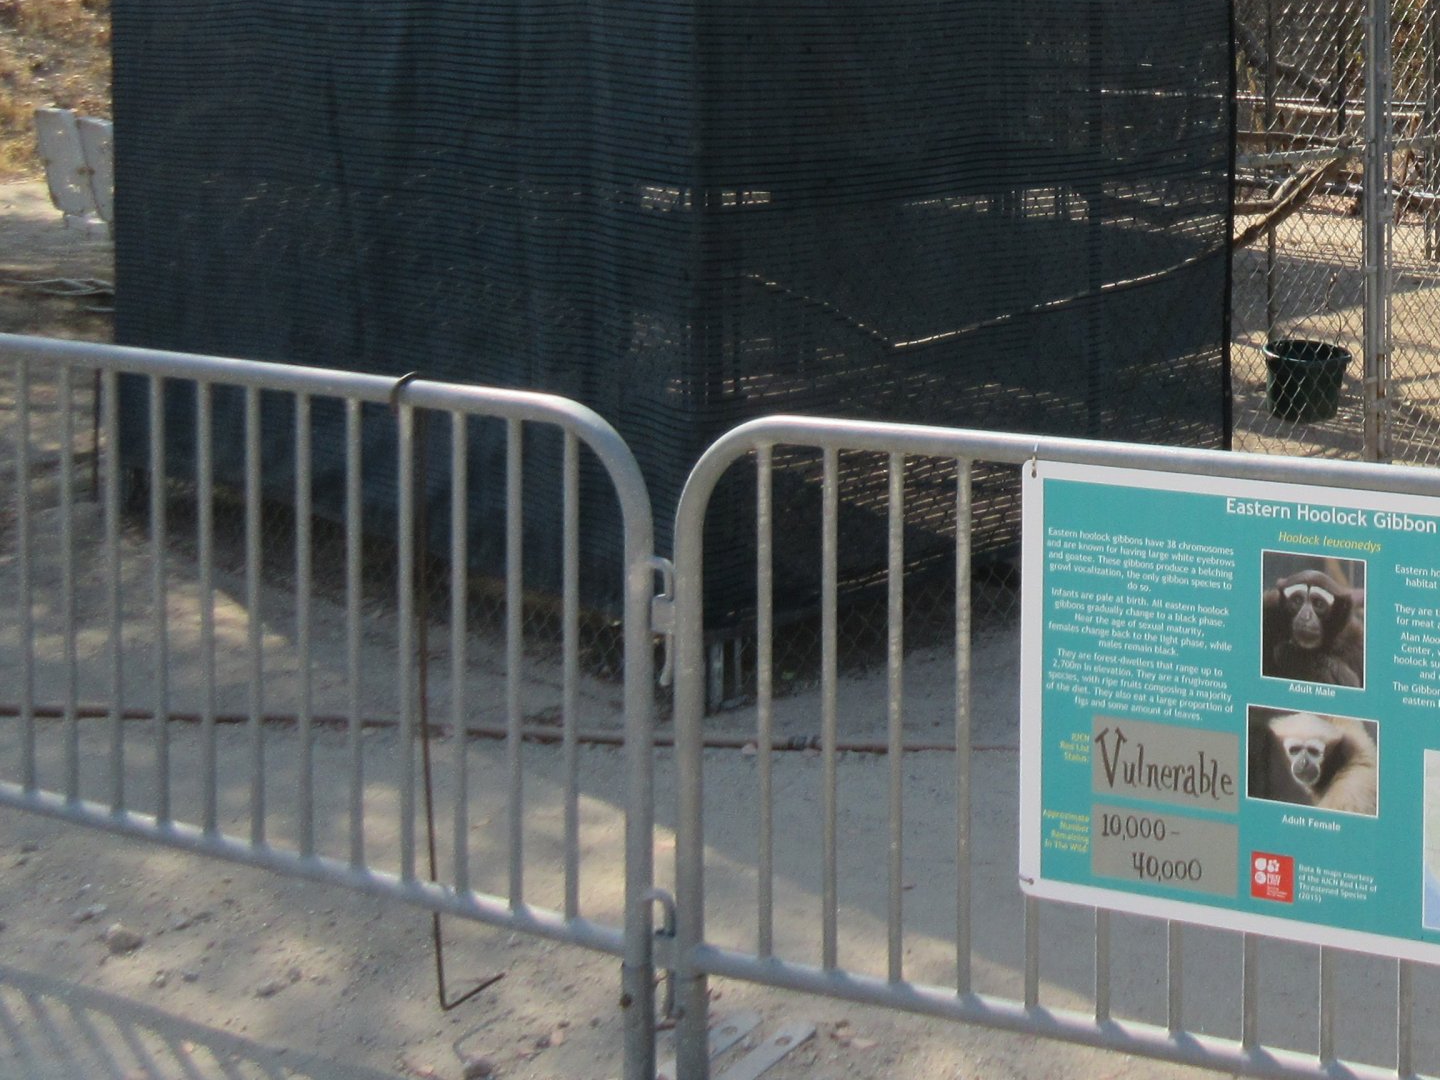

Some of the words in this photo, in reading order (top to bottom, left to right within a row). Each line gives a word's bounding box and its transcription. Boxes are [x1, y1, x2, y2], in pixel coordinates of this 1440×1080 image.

[1225, 496, 1290, 520] Eastern
[1297, 503, 1366, 527] Hoolock
[1373, 510, 1437, 533] Gibbon
[1049, 526, 1077, 538] Eastern
[1079, 530, 1110, 542] hoolock
[1112, 534, 1143, 545] gibbons
[1144, 537, 1164, 548] have
[1166, 539, 1176, 549] 38
[1178, 541, 1234, 555] chromosomes
[1278, 531, 1319, 545] Hoolock
[1322, 535, 1383, 553] leuconedys
[1047, 538, 1061, 548] and
[1063, 541, 1076, 549] are
[1078, 541, 1104, 552] known
[1106, 544, 1117, 554] for
[1119, 545, 1146, 559] having
[1148, 548, 1169, 561] large
[1171, 552, 1194, 562] white
[1196, 555, 1236, 567] eyebrows
[1049, 550, 1063, 560] and
[1098, 554, 1121, 566] These
[1122, 557, 1154, 569] gibbons
[1155, 562, 1188, 573] produce
[1190, 566, 1196, 574] a
[1198, 565, 1233, 579] belching
[1395, 565, 1428, 577] Eastern
[1050, 561, 1071, 571] growl
[1126, 568, 1140, 579] the
[1141, 571, 1159, 583] only
[1161, 573, 1188, 584] gibbon
[1190, 578, 1220, 588] species
[1222, 581, 1232, 590] to
[1406, 577, 1436, 589] habitat
[1127, 580, 1138, 590] do
[1080, 592, 1094, 600] are
[1095, 592, 1113, 603] pale
[1115, 595, 1123, 604] at
[1151, 598, 1162, 608] All
[1164, 601, 1195, 612] eastern
[1197, 603, 1229, 615] hoolock
[1395, 604, 1415, 617] They
[1418, 609, 1432, 617] are
[1397, 616, 1408, 626] for
[1412, 620, 1433, 628] meat
[1401, 631, 1420, 642] Alan
[1098, 639, 1122, 649] males
[1123, 643, 1152, 653] remain
[1154, 644, 1178, 656] black.
[1058, 647, 1076, 660] They
[1078, 652, 1091, 660] are
[1093, 651, 1154, 668] forest-dwellers
[1156, 660, 1172, 670] that
[1175, 664, 1198, 675] range
[1200, 667, 1211, 677] up
[1213, 668, 1223, 676] to
[1394, 655, 1427, 667] hoolock
[1420, 670, 1435, 680] and
[1289, 682, 1312, 694] Adult
[1315, 685, 1336, 697] Male
[1393, 682, 1408, 693] The
[1403, 697, 1435, 707] eastern
[1095, 726, 1234, 800] Vulnerable
[1282, 814, 1305, 826] Adult
[1308, 818, 1341, 831] Female
[1132, 851, 1202, 882] 40,000
